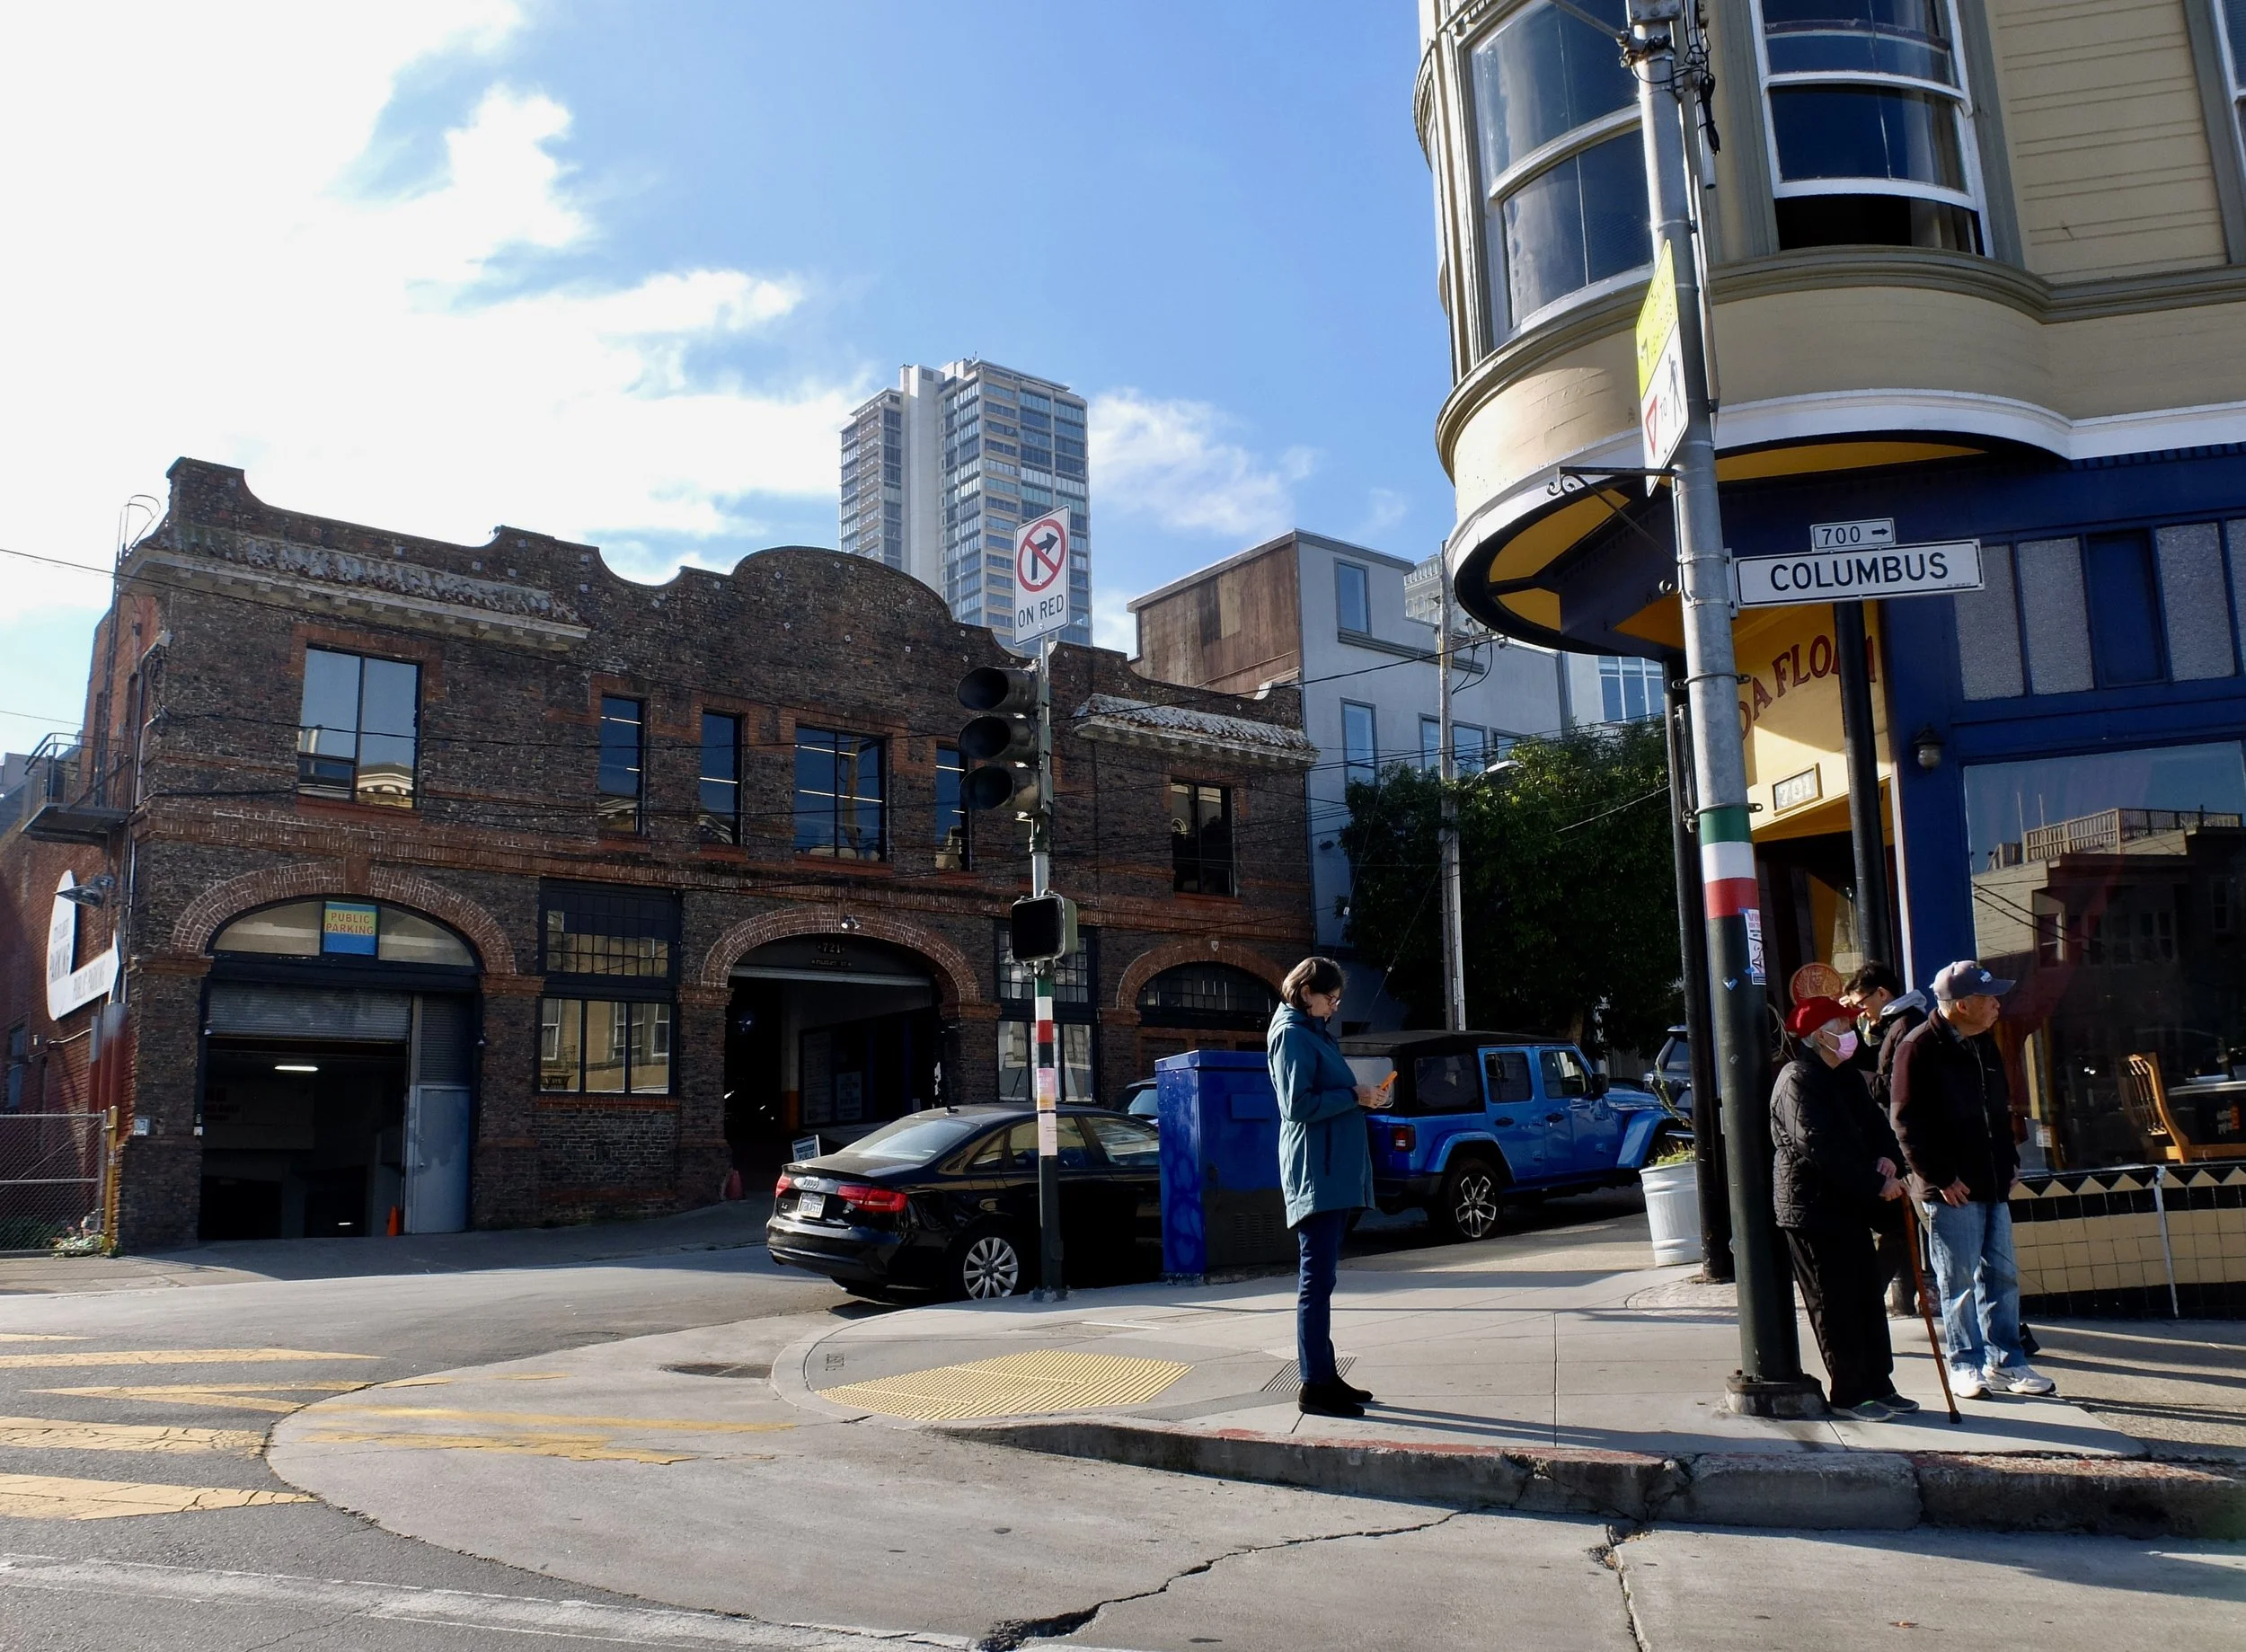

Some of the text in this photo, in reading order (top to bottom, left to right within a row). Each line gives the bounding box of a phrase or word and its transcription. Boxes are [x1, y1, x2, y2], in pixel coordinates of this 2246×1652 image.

[1822, 526, 1861, 546] 700
[1770, 552, 1949, 592] COLUMBUS
[1018, 594, 1064, 628] ON RED
[1772, 634, 1877, 698] FLO
[1779, 775, 1813, 807] 701
[325, 923, 374, 934] PARKING
[331, 913, 370, 923] PUBLIC
[823, 942, 841, 953] 721
